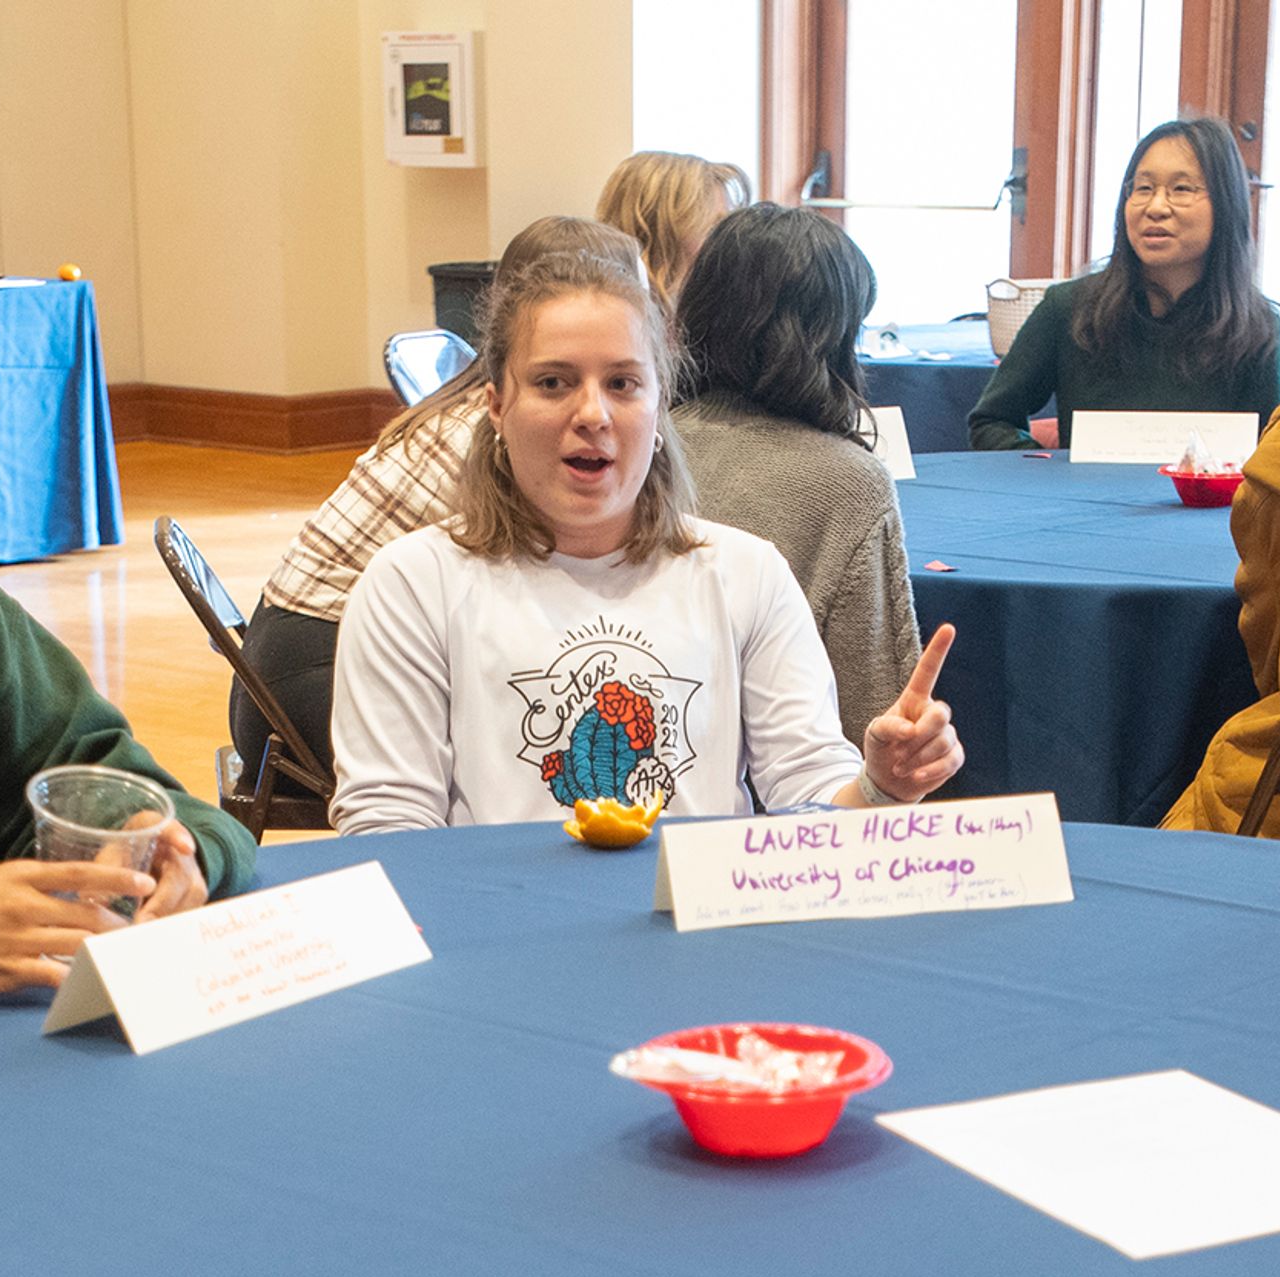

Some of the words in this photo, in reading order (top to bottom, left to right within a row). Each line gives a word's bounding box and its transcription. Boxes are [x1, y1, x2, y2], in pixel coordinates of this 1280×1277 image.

[522, 650, 617, 747] Centex
[660, 703, 678, 725] 20
[744, 824, 843, 854] LAUREL
[862, 812, 943, 844] HICKE
[732, 864, 841, 899] University
[855, 861, 880, 882] of
[889, 857, 975, 897] Chicago
